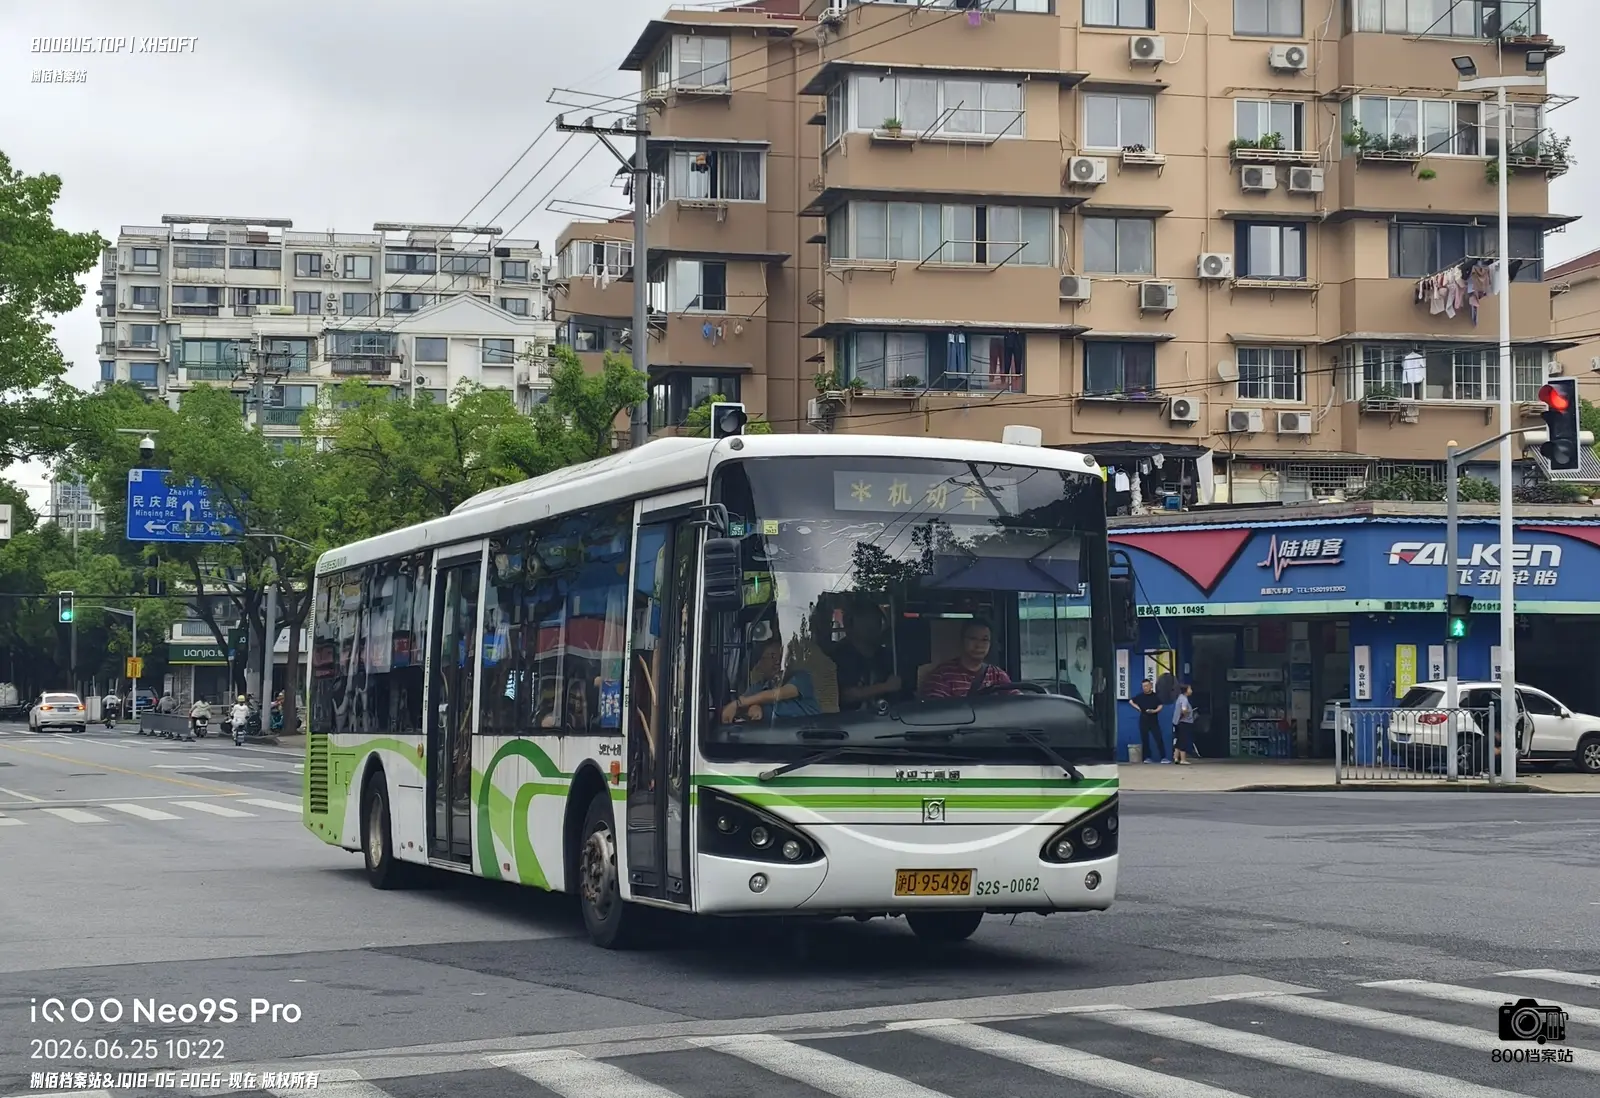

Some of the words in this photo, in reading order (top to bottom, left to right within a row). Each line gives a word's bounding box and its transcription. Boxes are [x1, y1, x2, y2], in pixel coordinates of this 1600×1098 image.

[133, 495, 178, 508] 民庆路
[135, 509, 163, 518] Minqing
[1278, 538, 1344, 558] 陆博客
[1456, 569, 1558, 586] 飞劲轮胎
[976, 877, 1040, 896] S2S-0062
